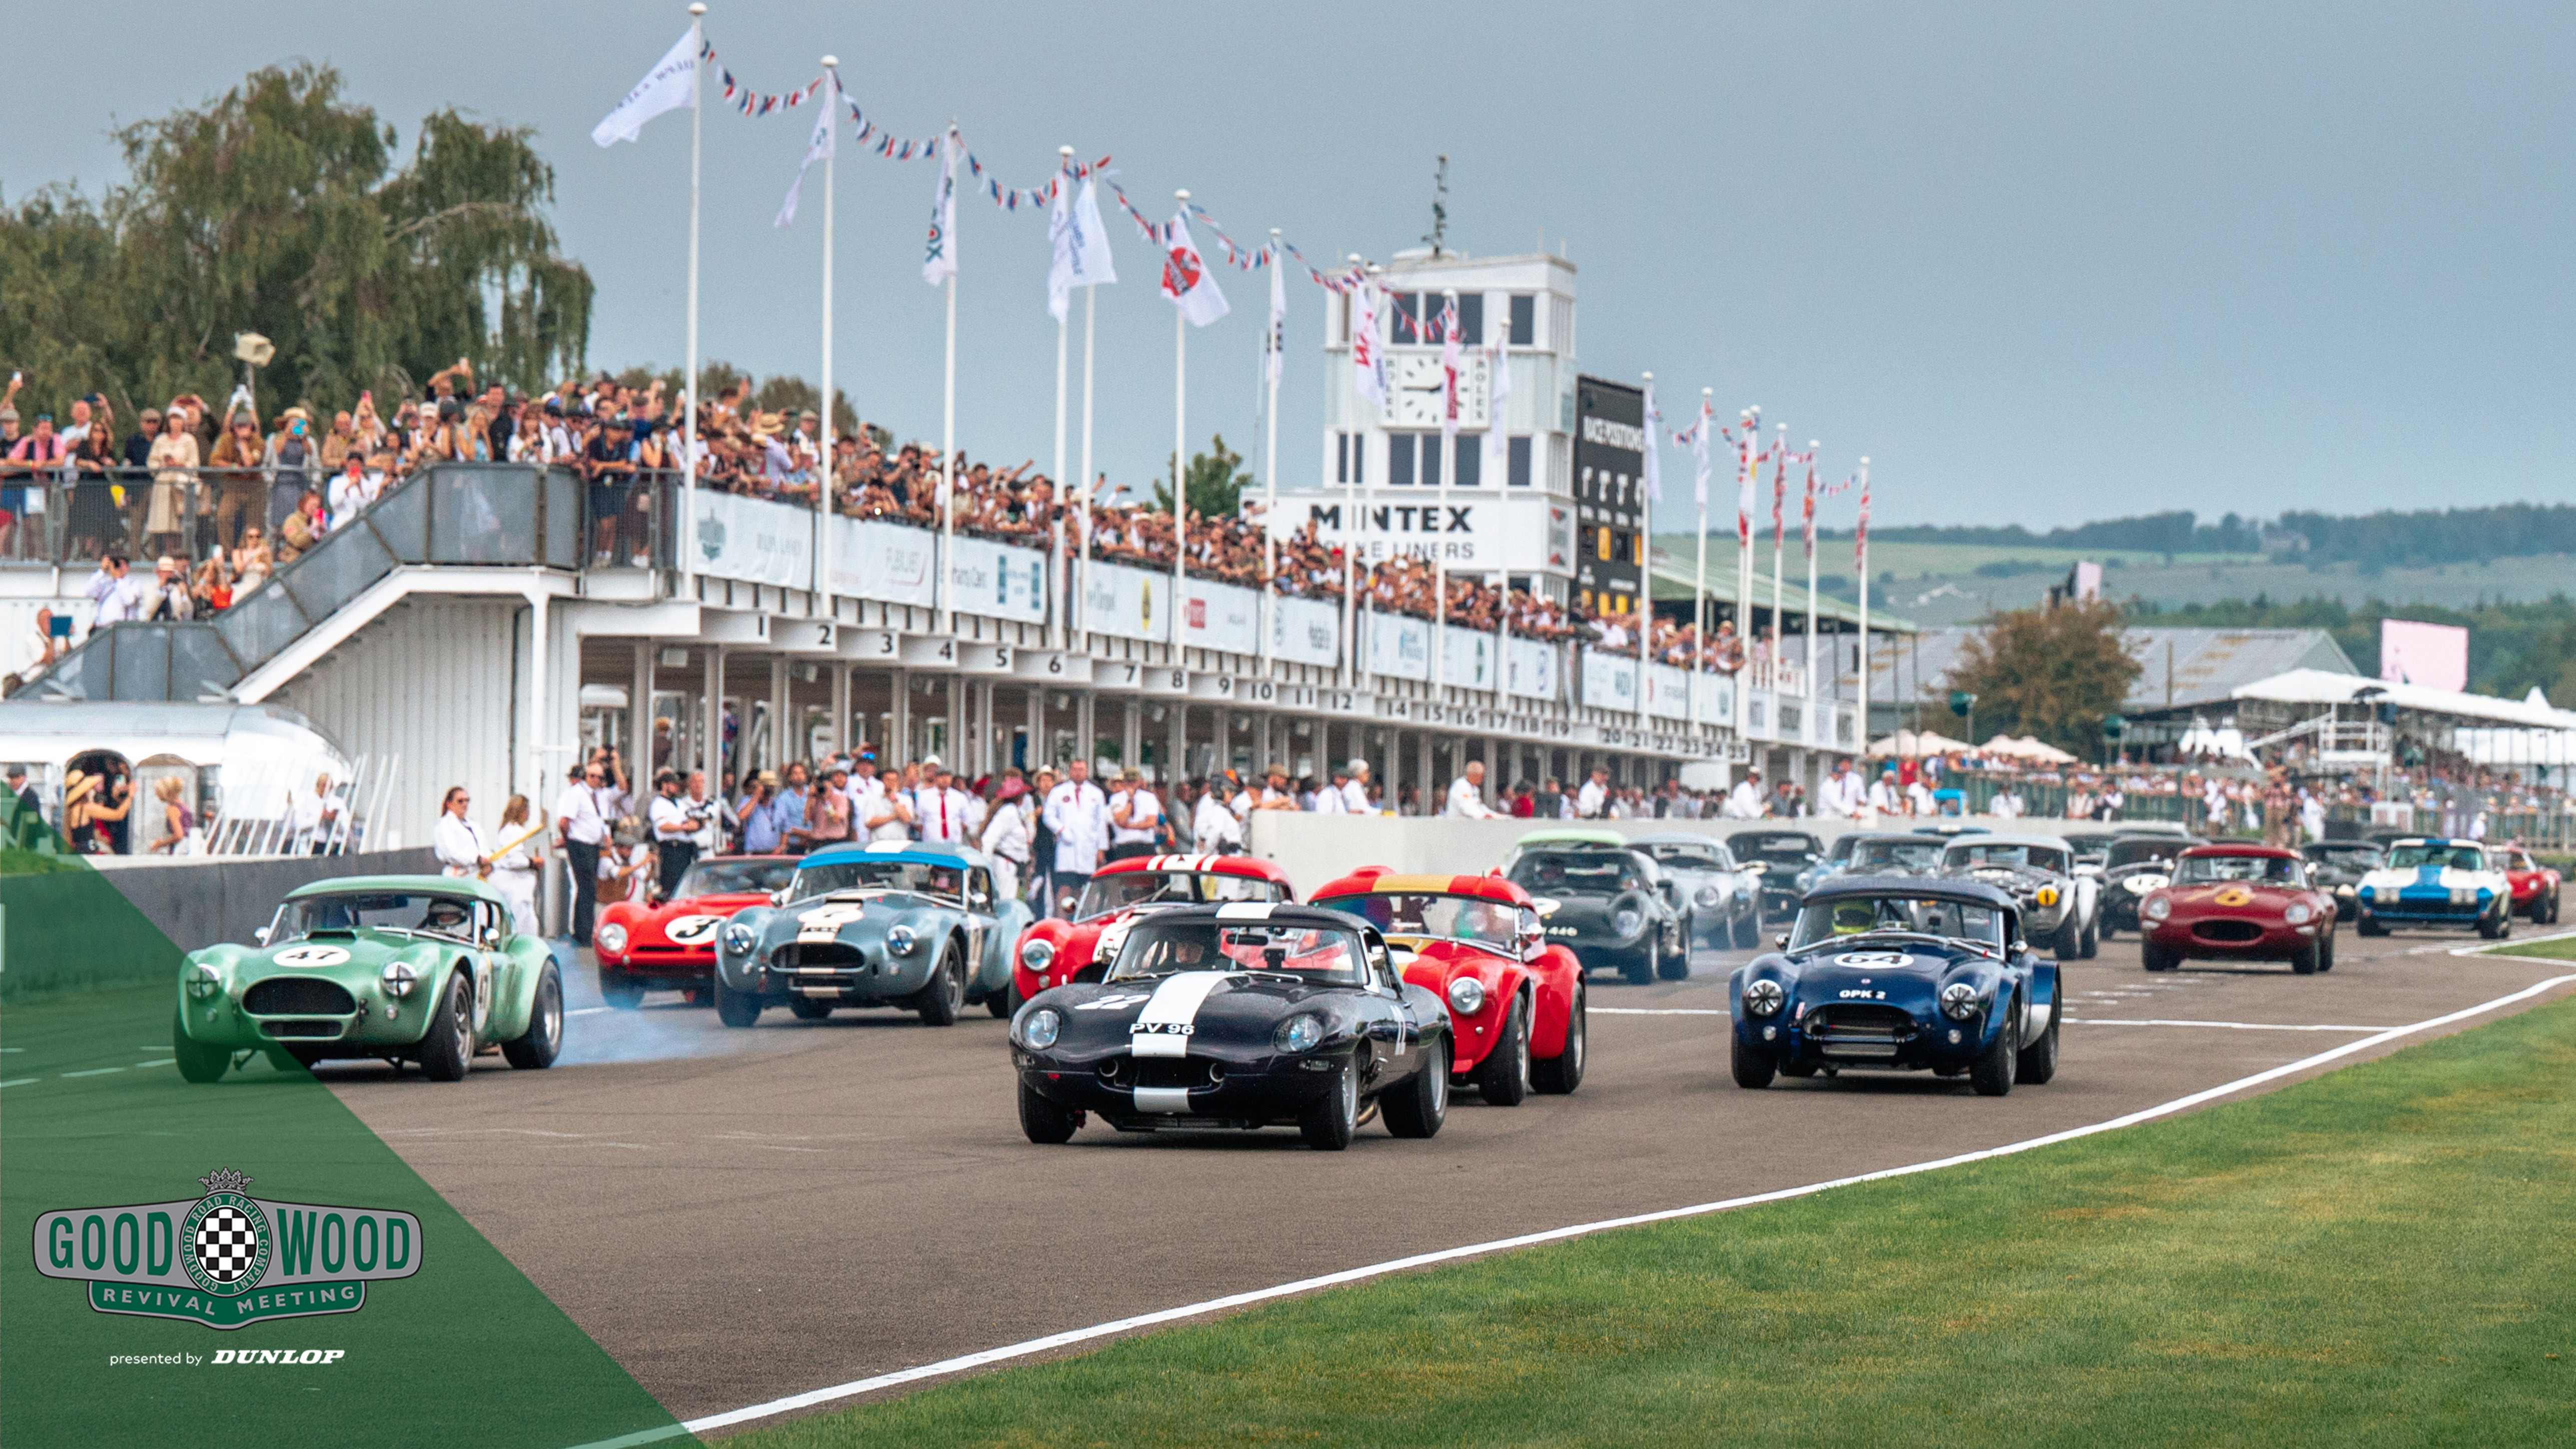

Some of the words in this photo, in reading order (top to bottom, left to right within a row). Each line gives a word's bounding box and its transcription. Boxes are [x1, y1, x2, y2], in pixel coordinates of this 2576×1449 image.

[1311, 504, 1473, 532] MINTEX
[758, 615, 764, 636] 1
[818, 625, 831, 645] 2
[880, 633, 892, 653] 3
[938, 642, 952, 661] 4
[995, 649, 1007, 667] 5
[1049, 656, 1061, 674] 6
[1124, 664, 1136, 682] 7
[1171, 670, 1183, 689] 8
[1218, 677, 1230, 694] 9
[1251, 682, 1272, 700] 10
[1295, 688, 1313, 705] 11
[1332, 693, 1352, 709] 12
[1387, 702, 1406, 716] 14
[1424, 704, 1443, 721] 15
[1456, 708, 1476, 726] 16
[1489, 712, 1508, 729] 17
[675, 918, 719, 938] 3
[285, 950, 340, 960] 47
[1074, 994, 1151, 1010] 22
[1839, 989, 1873, 999] OPK
[1876, 990, 1887, 1000] 2
[1129, 1023, 1162, 1034] PV
[1167, 1023, 1195, 1035] 96
